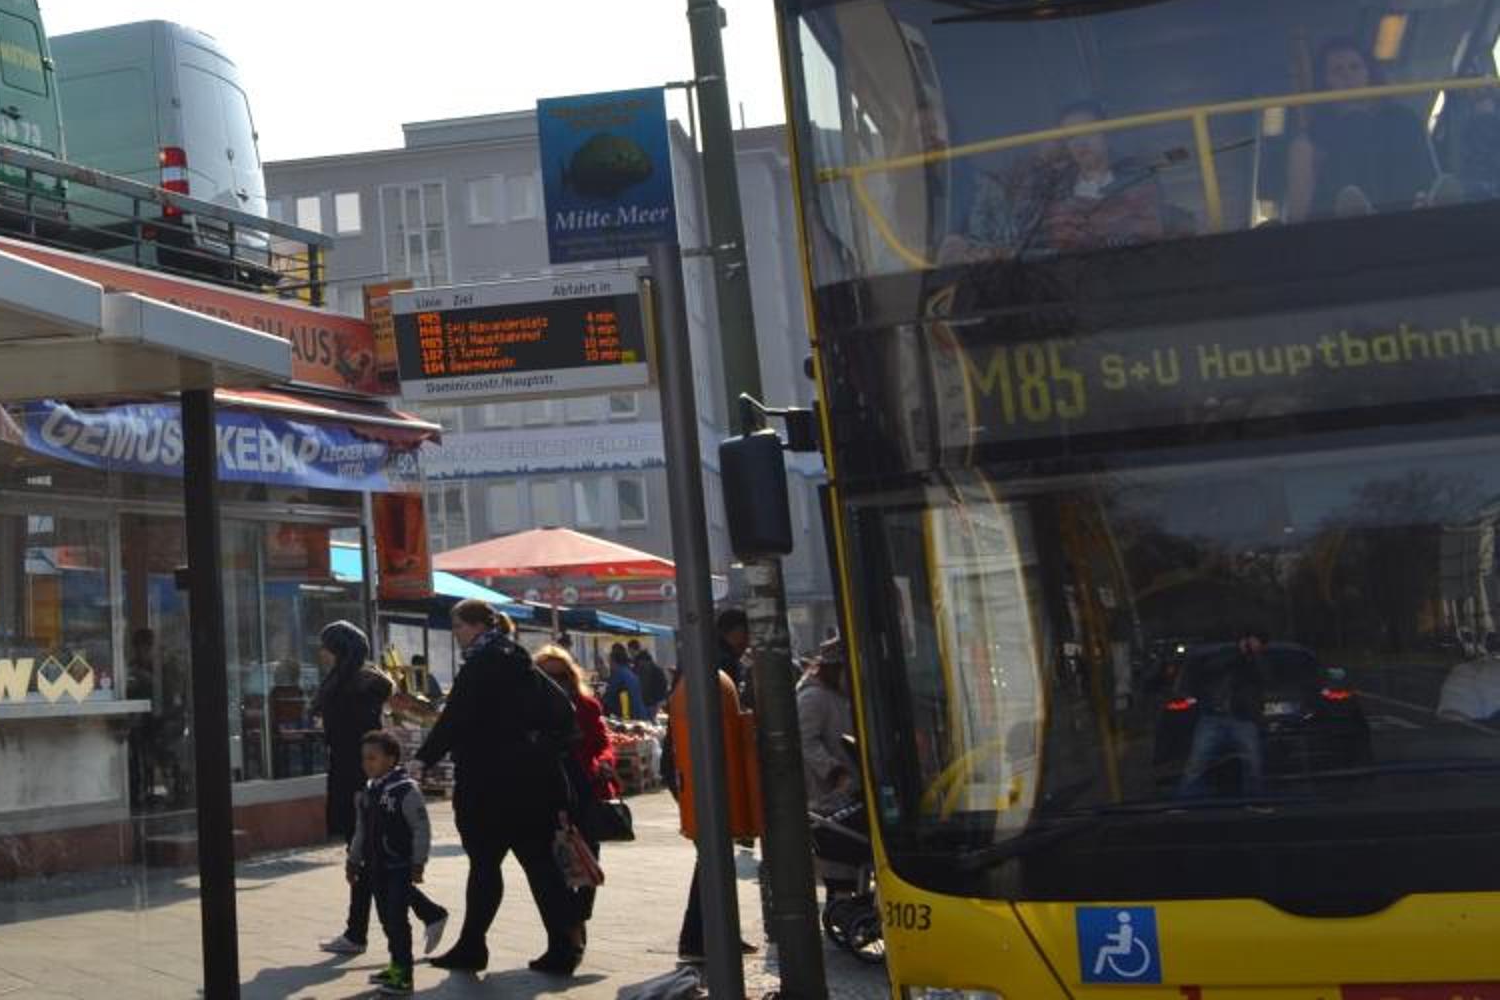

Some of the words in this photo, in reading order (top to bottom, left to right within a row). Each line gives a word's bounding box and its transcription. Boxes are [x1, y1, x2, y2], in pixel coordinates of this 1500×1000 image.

[554, 209, 611, 232] Mitte
[616, 203, 670, 227] Meer
[552, 282, 597, 297] Abfahrt
[963, 340, 1090, 426] M85
[1100, 346, 1182, 392] S+U
[40, 405, 185, 466] GEMÜS
